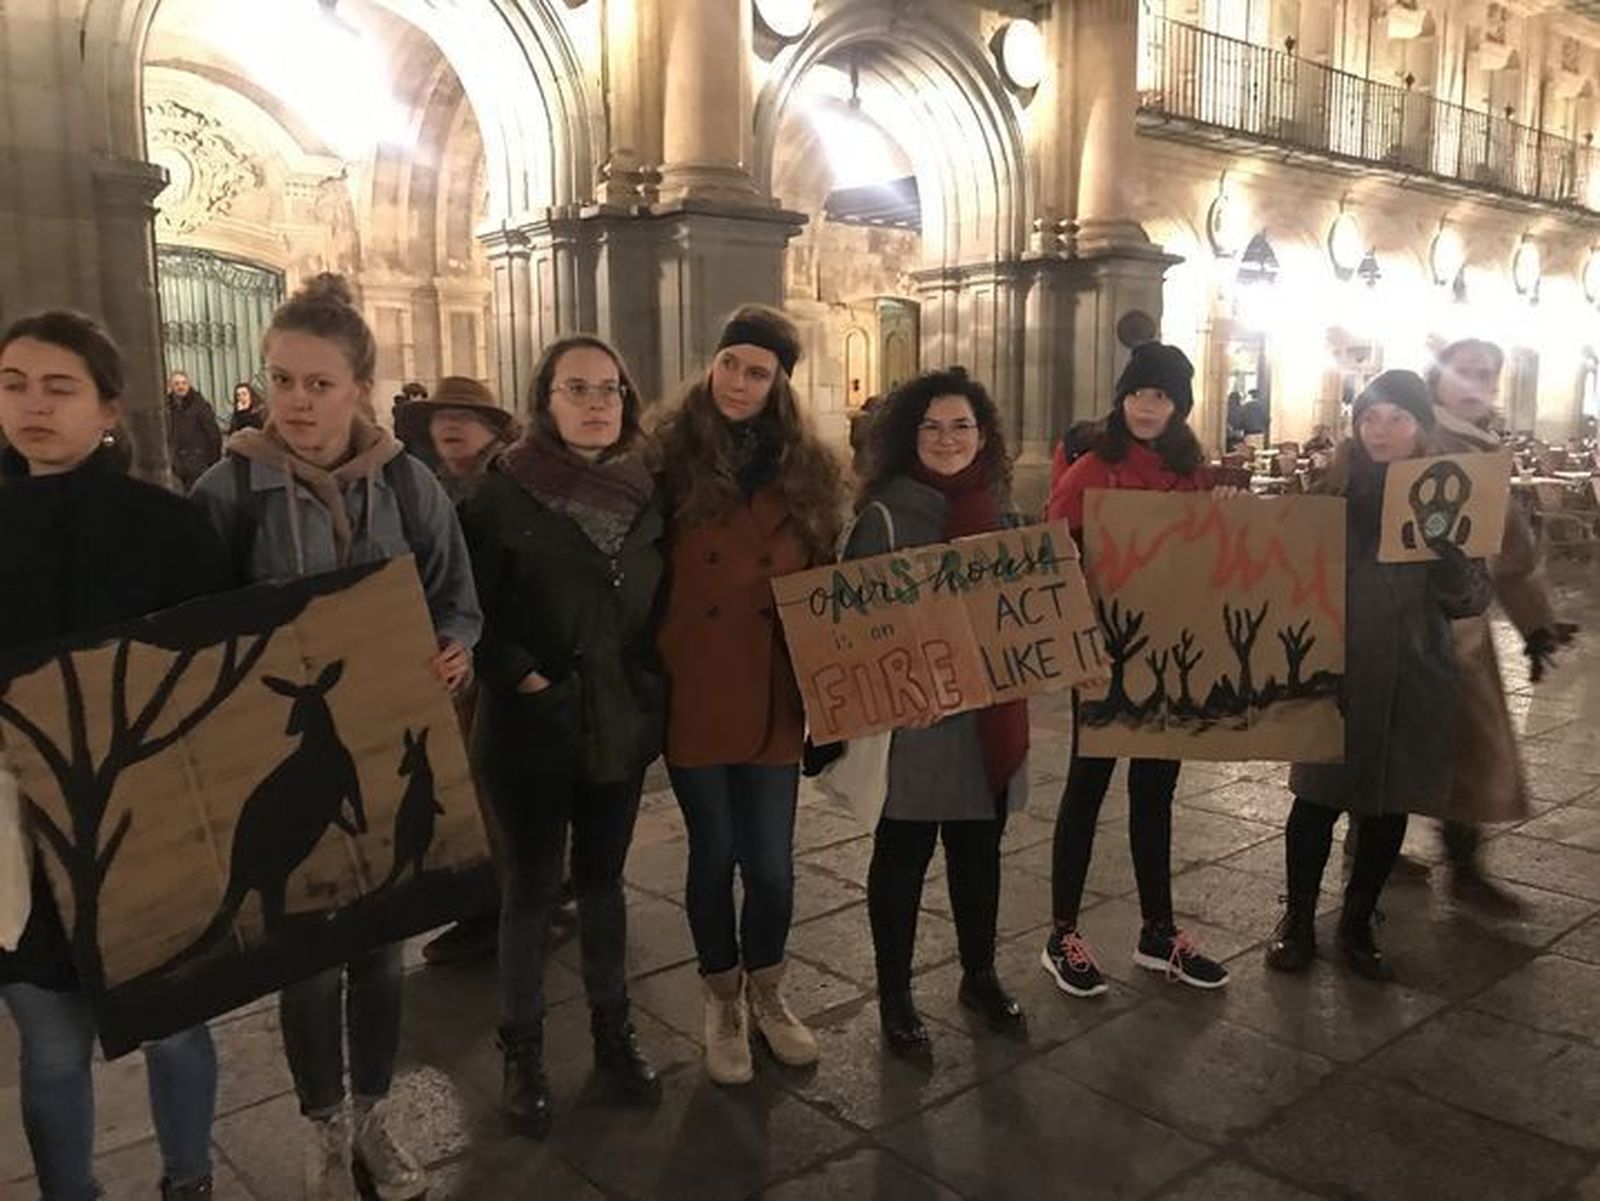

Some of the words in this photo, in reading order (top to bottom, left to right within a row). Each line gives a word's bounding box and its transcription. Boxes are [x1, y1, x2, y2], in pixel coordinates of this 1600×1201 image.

[996, 581, 1067, 633] ACT
[812, 638, 964, 735] FIRE
[980, 637, 1062, 692] LIKE
[1073, 626, 1101, 671] IT
